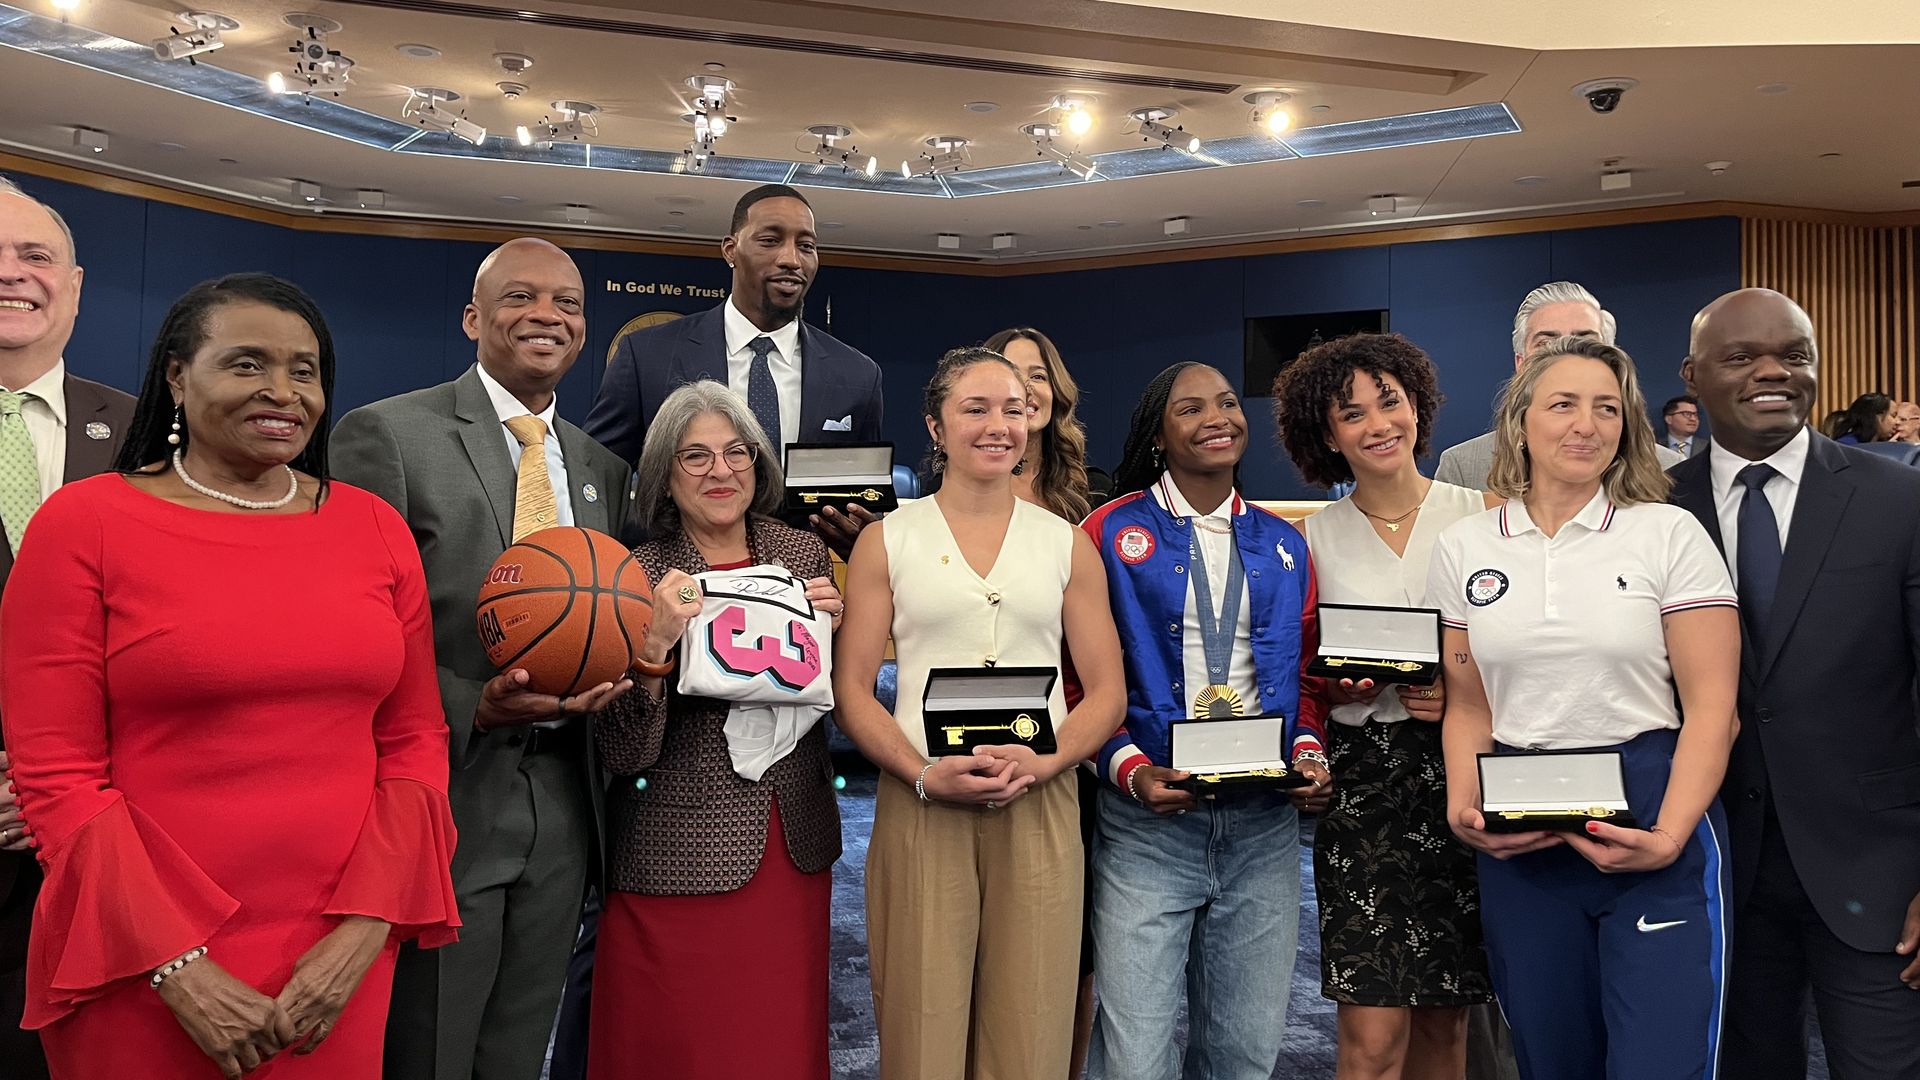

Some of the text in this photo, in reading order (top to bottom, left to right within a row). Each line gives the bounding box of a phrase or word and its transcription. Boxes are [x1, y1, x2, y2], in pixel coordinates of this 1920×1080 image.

[606, 280, 726, 298] In God We Trust
[705, 606, 821, 694] 3
